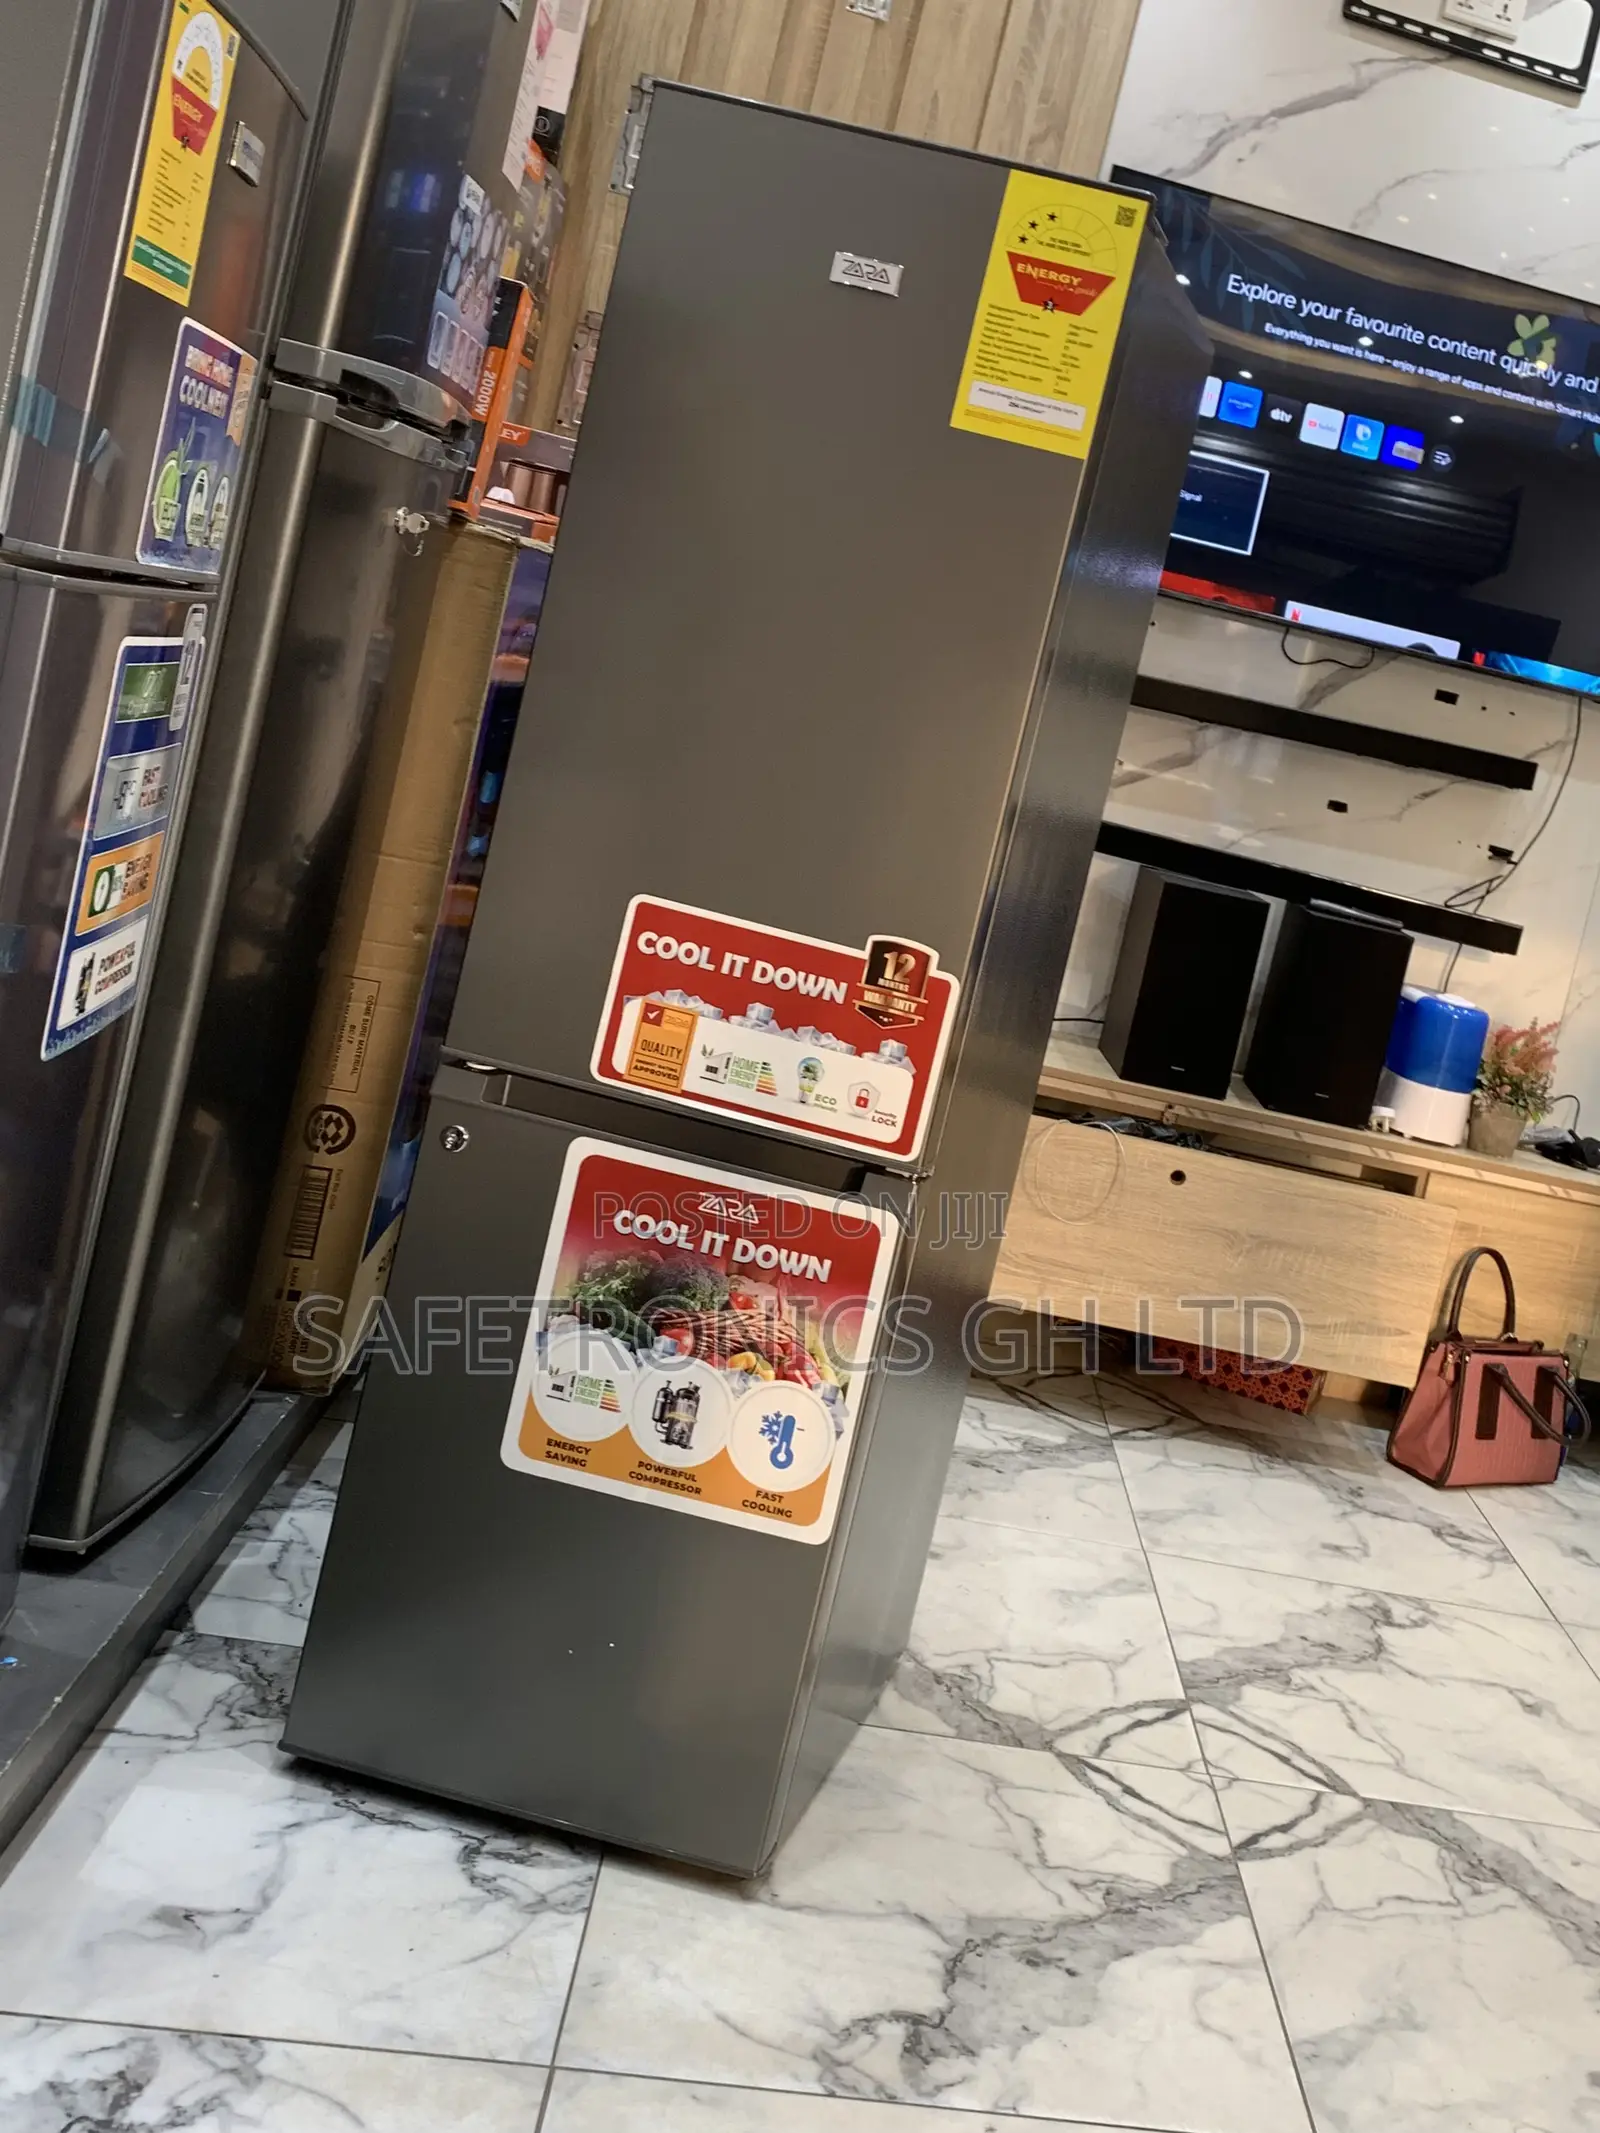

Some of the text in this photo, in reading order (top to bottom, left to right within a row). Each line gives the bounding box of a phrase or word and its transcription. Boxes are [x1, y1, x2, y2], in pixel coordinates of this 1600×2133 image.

[1016, 262, 1083, 286] ENERGY
[1226, 273, 1599, 394] Explore your favourite content quickly and
[1264, 322, 1313, 346] Everything
[1314, 337, 1331, 349] you
[1332, 341, 1355, 356] want
[1364, 350, 1385, 364] here
[1392, 359, 1417, 374] enjoy
[1425, 366, 1451, 383] range
[1451, 374, 1462, 385] of
[1461, 378, 1483, 392] apps
[1483, 384, 1502, 397] and
[1502, 389, 1536, 406] content
[1556, 402, 1582, 419] Smart
[474, 371, 496, 417] 2000W
[636, 931, 848, 1005] COOL IT DOWN
[883, 951, 916, 983] 12
[350, 1039, 365, 1076] MATERIAL
[641, 1039, 683, 1060] QUALITY
[633, 1064, 680, 1081] APPROVED
[732, 1055, 761, 1074] HOME
[814, 1093, 837, 1106] ECO
[871, 1115, 898, 1128] LOCK
[698, 1191, 759, 1224] ZARA
[613, 1210, 832, 1284] COOL IT DOWN
[546, 1437, 592, 1457] ENERGY
[545, 1450, 588, 1468] SAVING
[628, 1470, 703, 1495] COMPRESSOR
[637, 1460, 698, 1483] POWERFUL
[755, 1489, 785, 1504] FAST
[742, 1499, 793, 1519] COOLING
